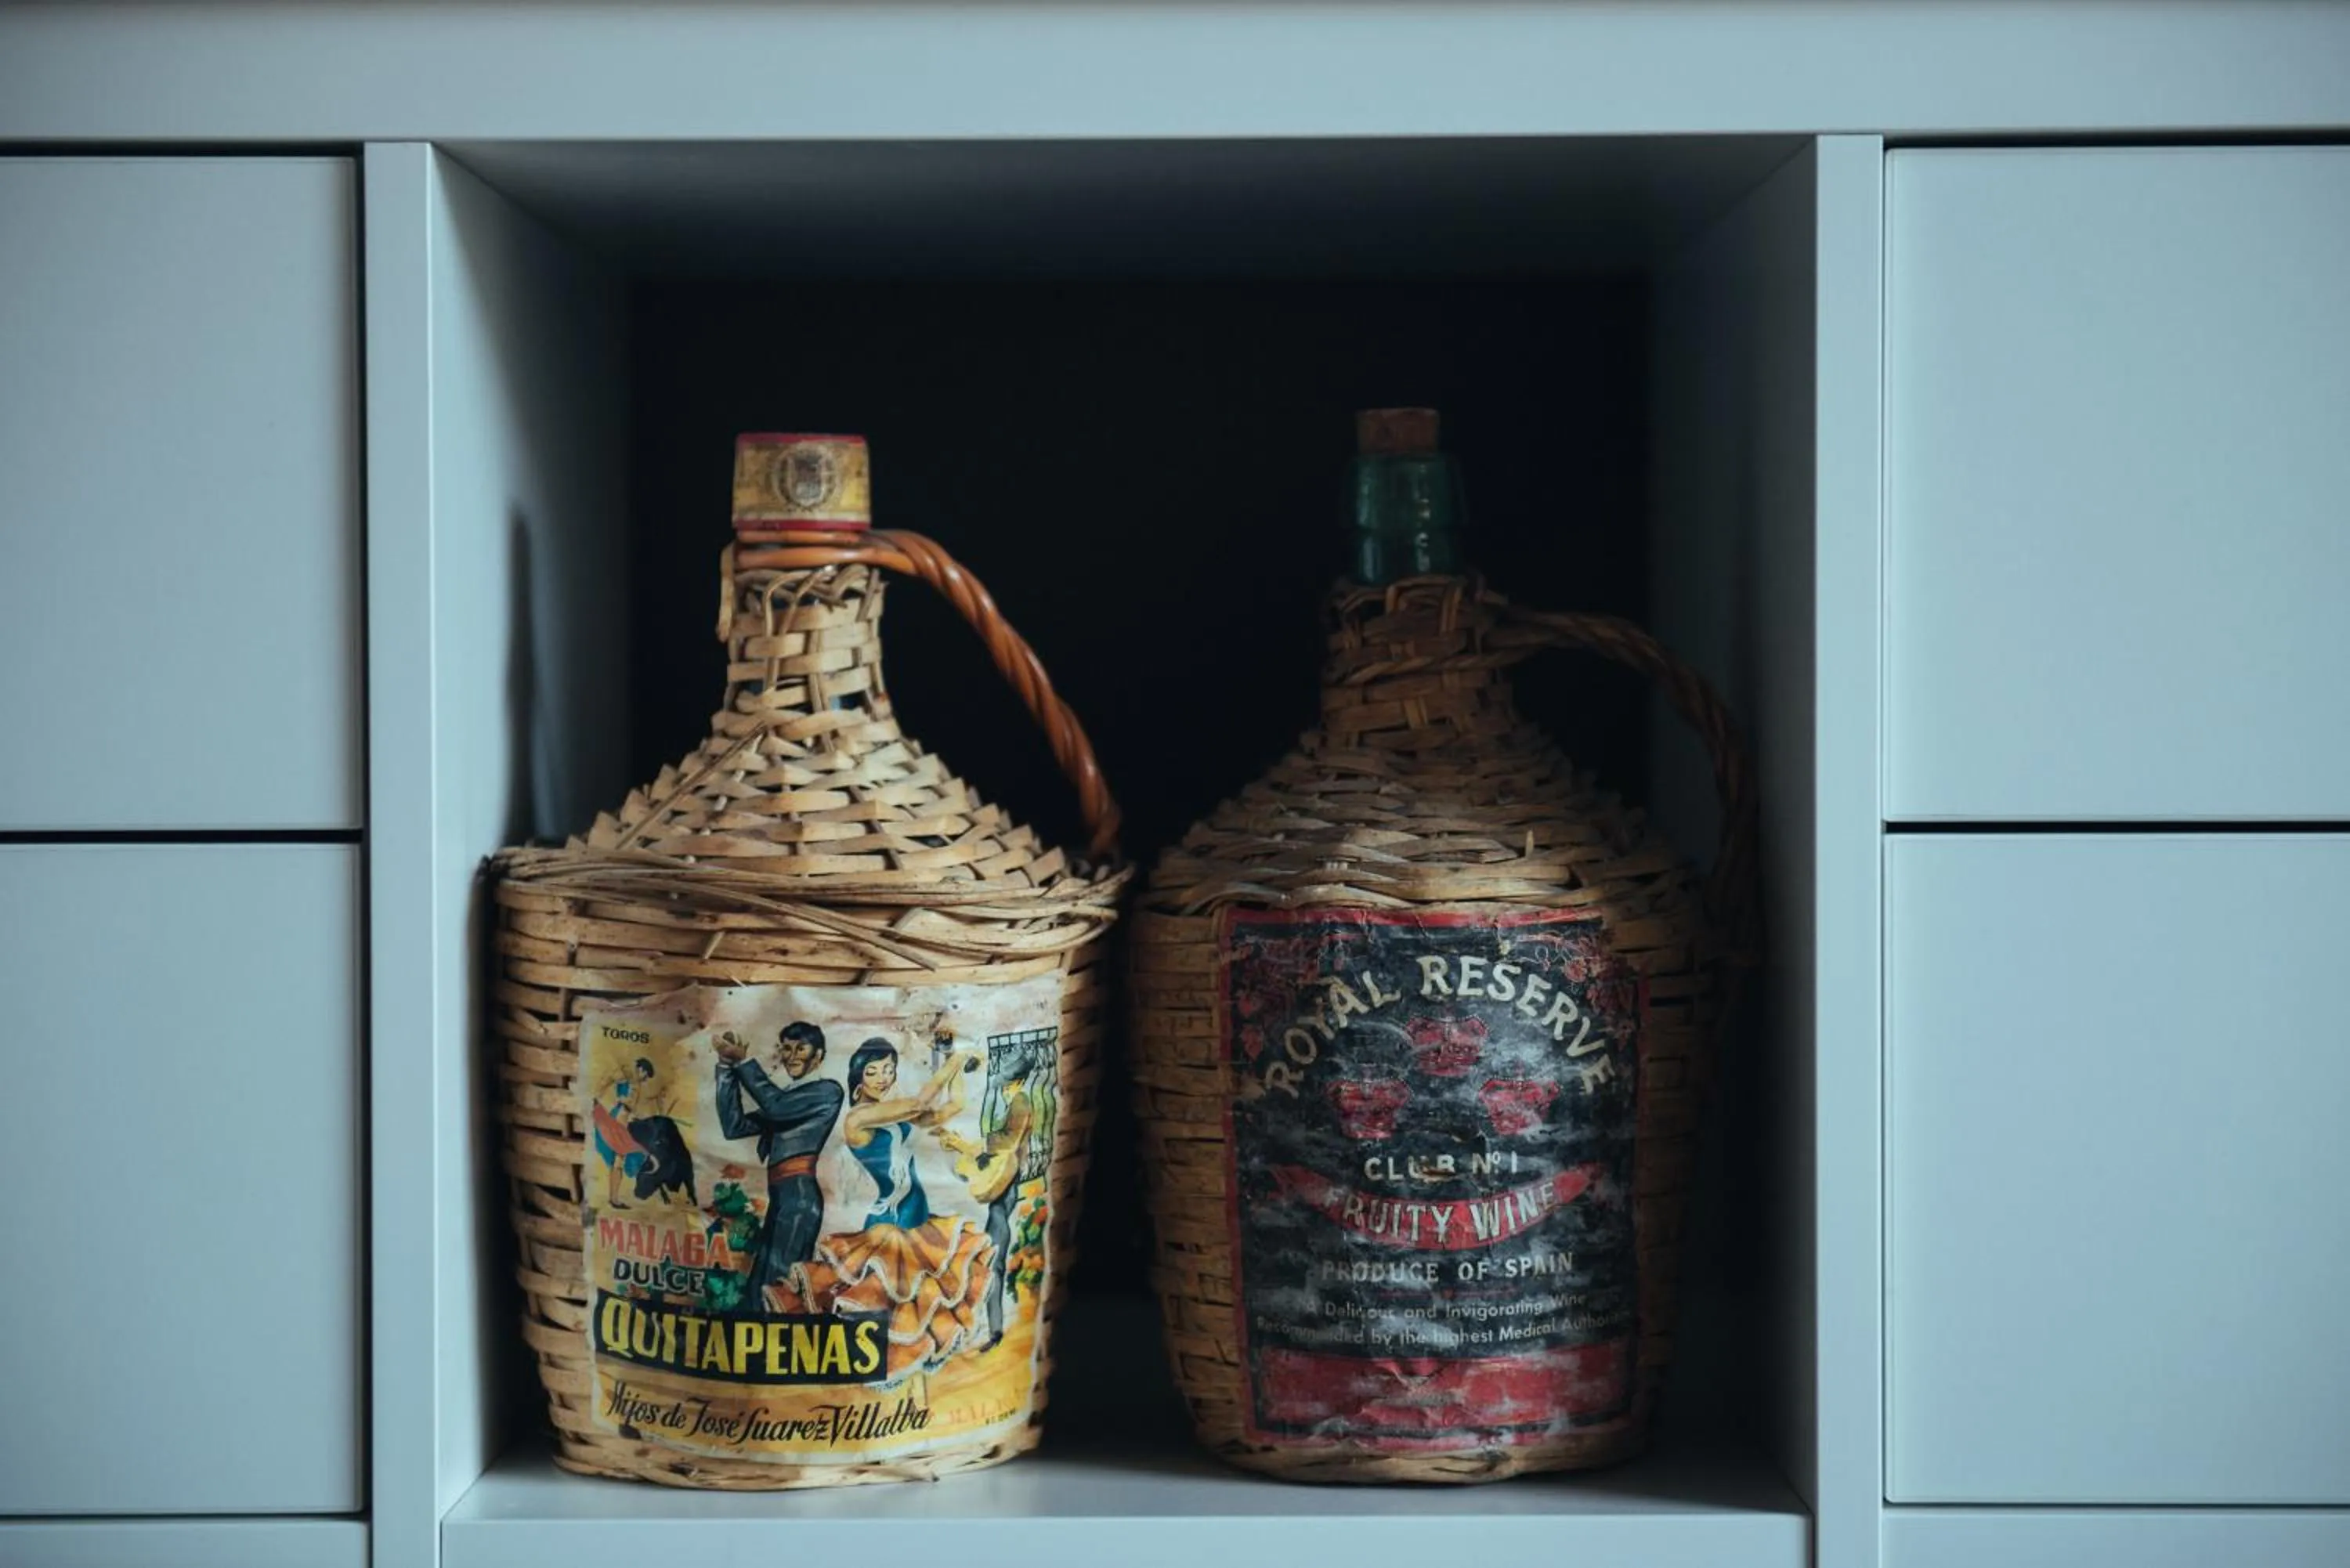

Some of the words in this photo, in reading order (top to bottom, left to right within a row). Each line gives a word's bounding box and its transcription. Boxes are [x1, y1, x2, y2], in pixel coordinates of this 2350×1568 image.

[1264, 970, 1401, 1098] ROYAL
[1415, 955, 1615, 1095] RESERVE
[1363, 1153, 1455, 1181] CLUB
[1325, 1186, 1453, 1243] FRUITY
[1470, 1181, 1555, 1241] WINE
[598, 1216, 732, 1269] MALAGA
[613, 1258, 705, 1295] DULCE
[1321, 1259, 1440, 1283] PRODUCE
[1457, 1261, 1491, 1280] OF
[1504, 1253, 1573, 1278] SPAIN
[1371, 1328, 1392, 1346] by
[1499, 1317, 1556, 1342] Medical
[1403, 1303, 1437, 1319] and
[1445, 1299, 1543, 1321] Invigorating
[600, 1296, 880, 1375] QUITAPENAS
[606, 1379, 661, 1425] Hijos
[660, 1402, 688, 1429] de
[684, 1396, 744, 1438] José
[808, 1396, 931, 1448] Villalba
